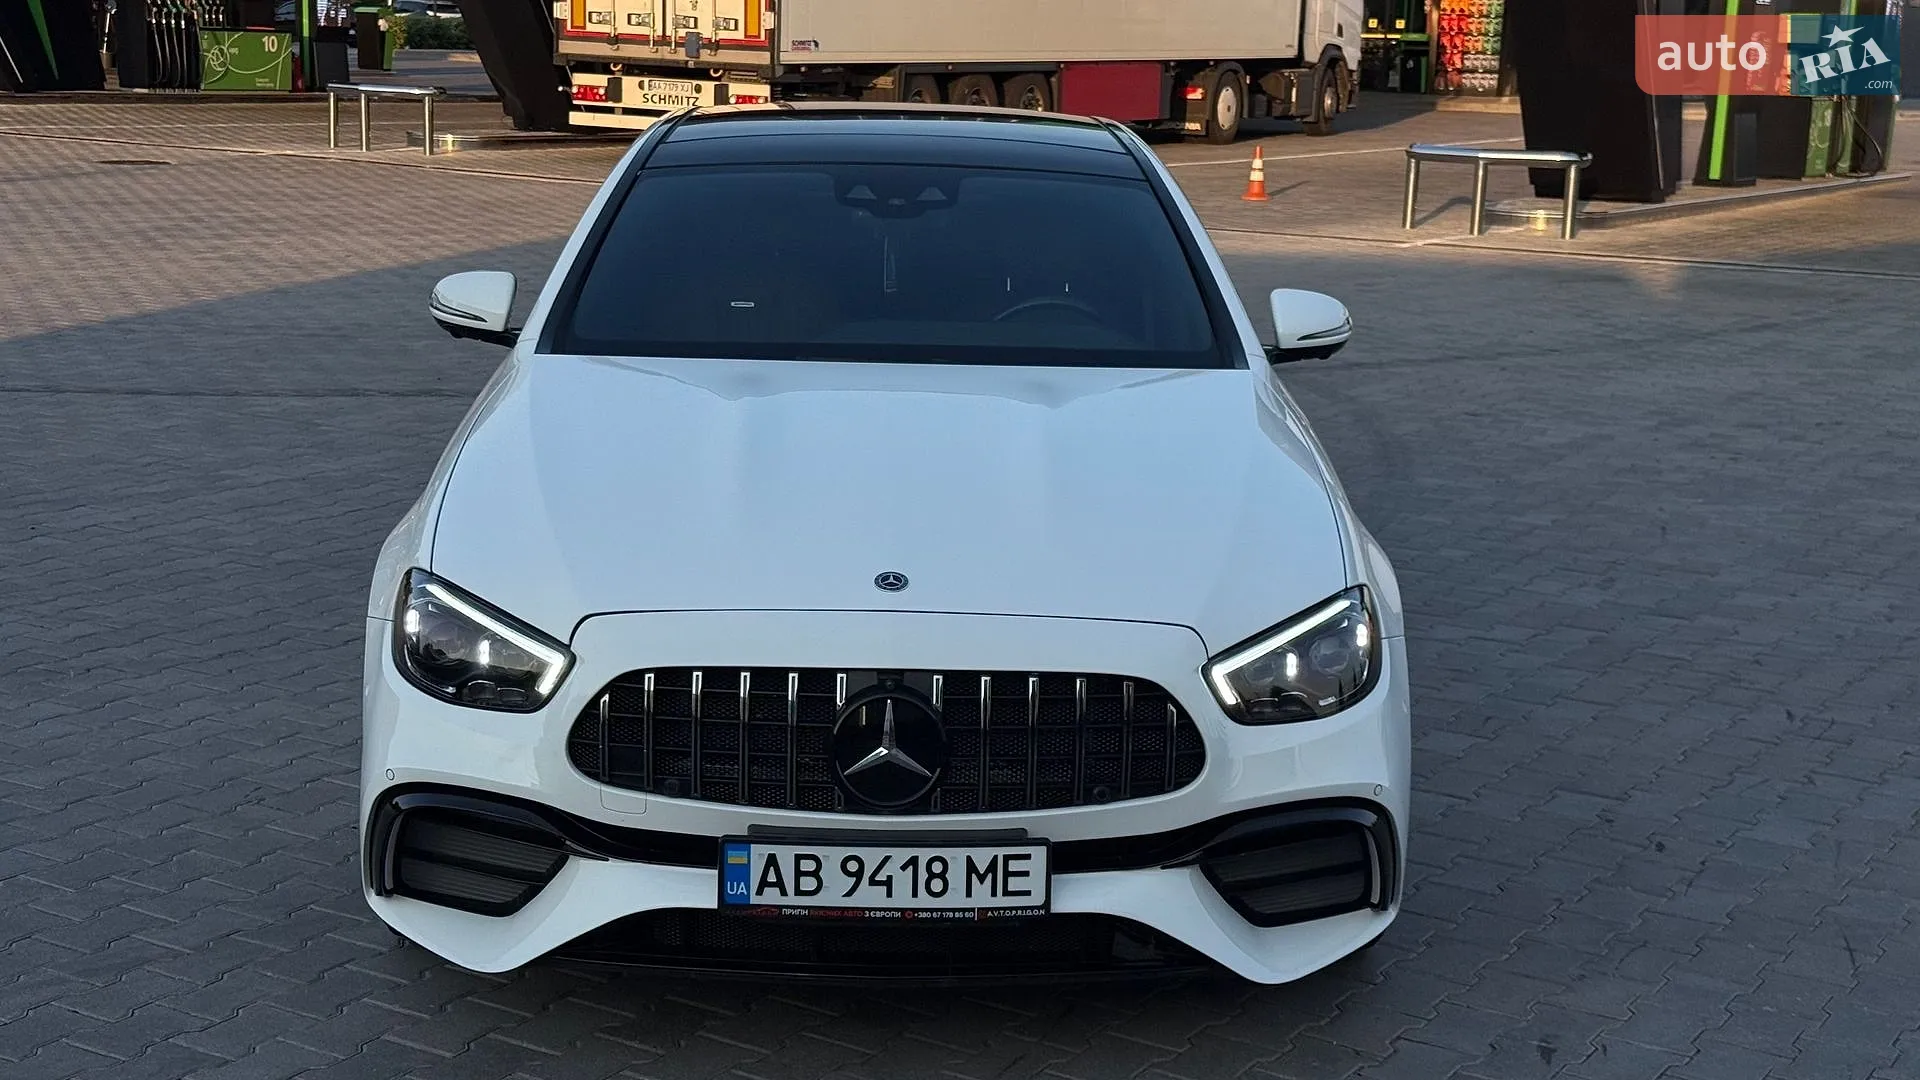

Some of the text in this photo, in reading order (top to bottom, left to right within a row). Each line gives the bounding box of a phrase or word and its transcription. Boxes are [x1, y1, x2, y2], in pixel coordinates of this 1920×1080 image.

[262, 35, 278, 52] 10
[642, 93, 700, 107] SCHMITZ
[754, 852, 1033, 899] AB 9418 ME
[727, 882, 747, 896] UA
